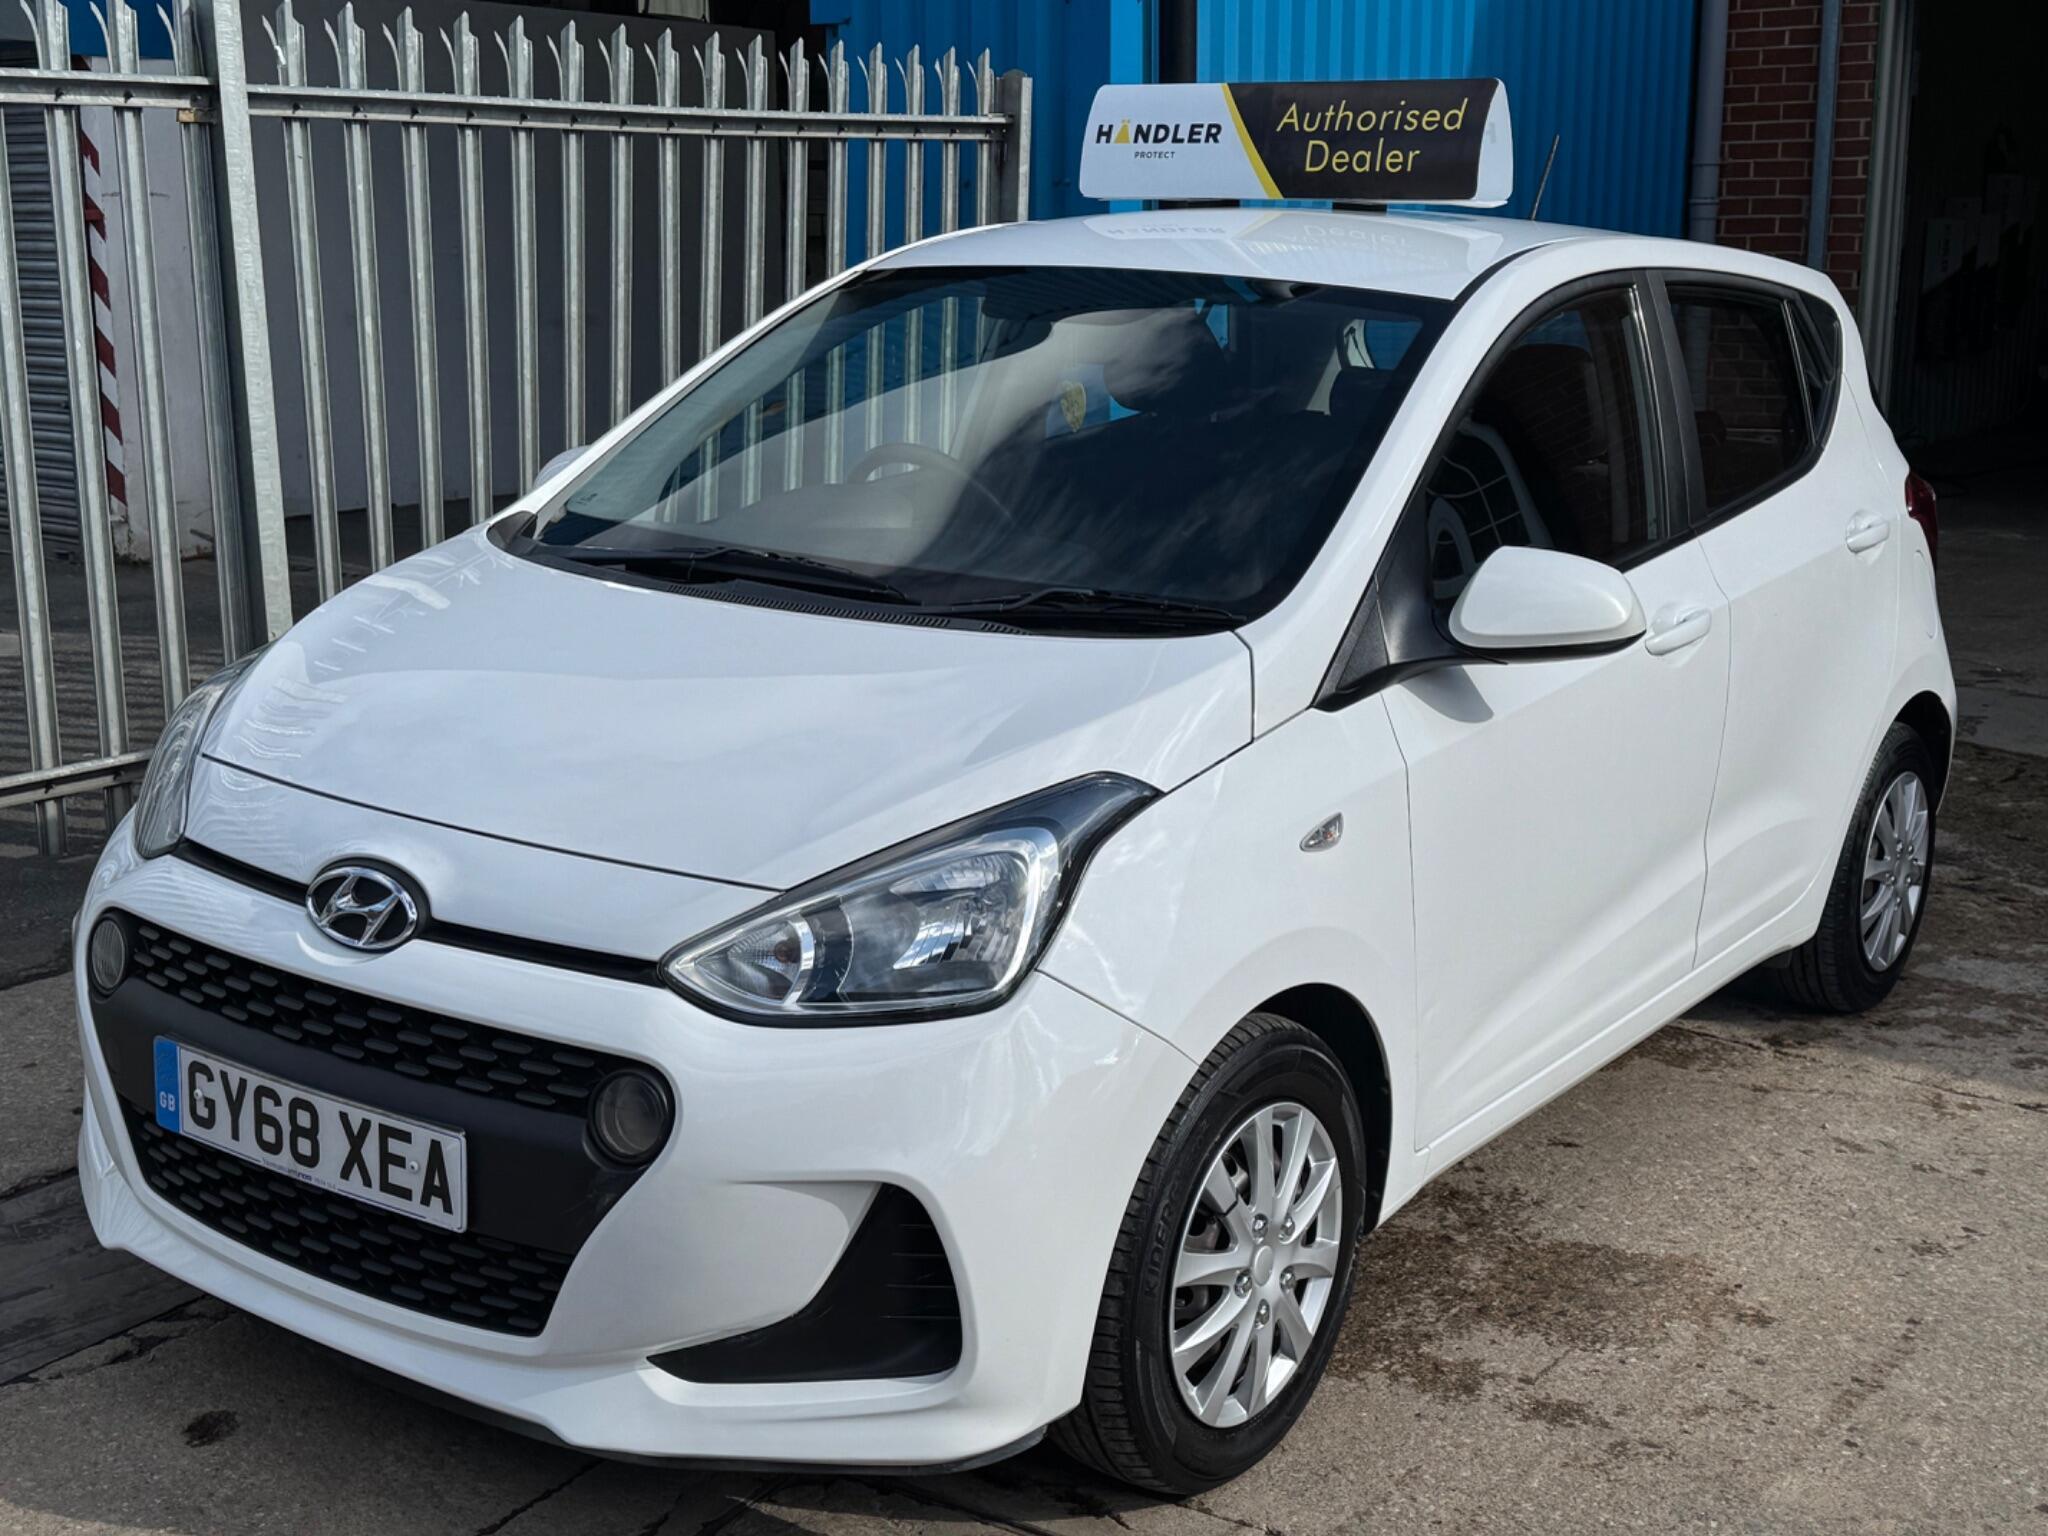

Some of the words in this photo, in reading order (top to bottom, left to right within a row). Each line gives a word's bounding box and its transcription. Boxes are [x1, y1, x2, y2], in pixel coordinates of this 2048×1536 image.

[1276, 97, 1469, 133] Authorised
[1134, 151, 1175, 159] PROTECT
[1304, 137, 1421, 172] Dealer
[159, 1091, 175, 1112] GB
[188, 1060, 321, 1169] GY68
[339, 1110, 454, 1216] XEA
